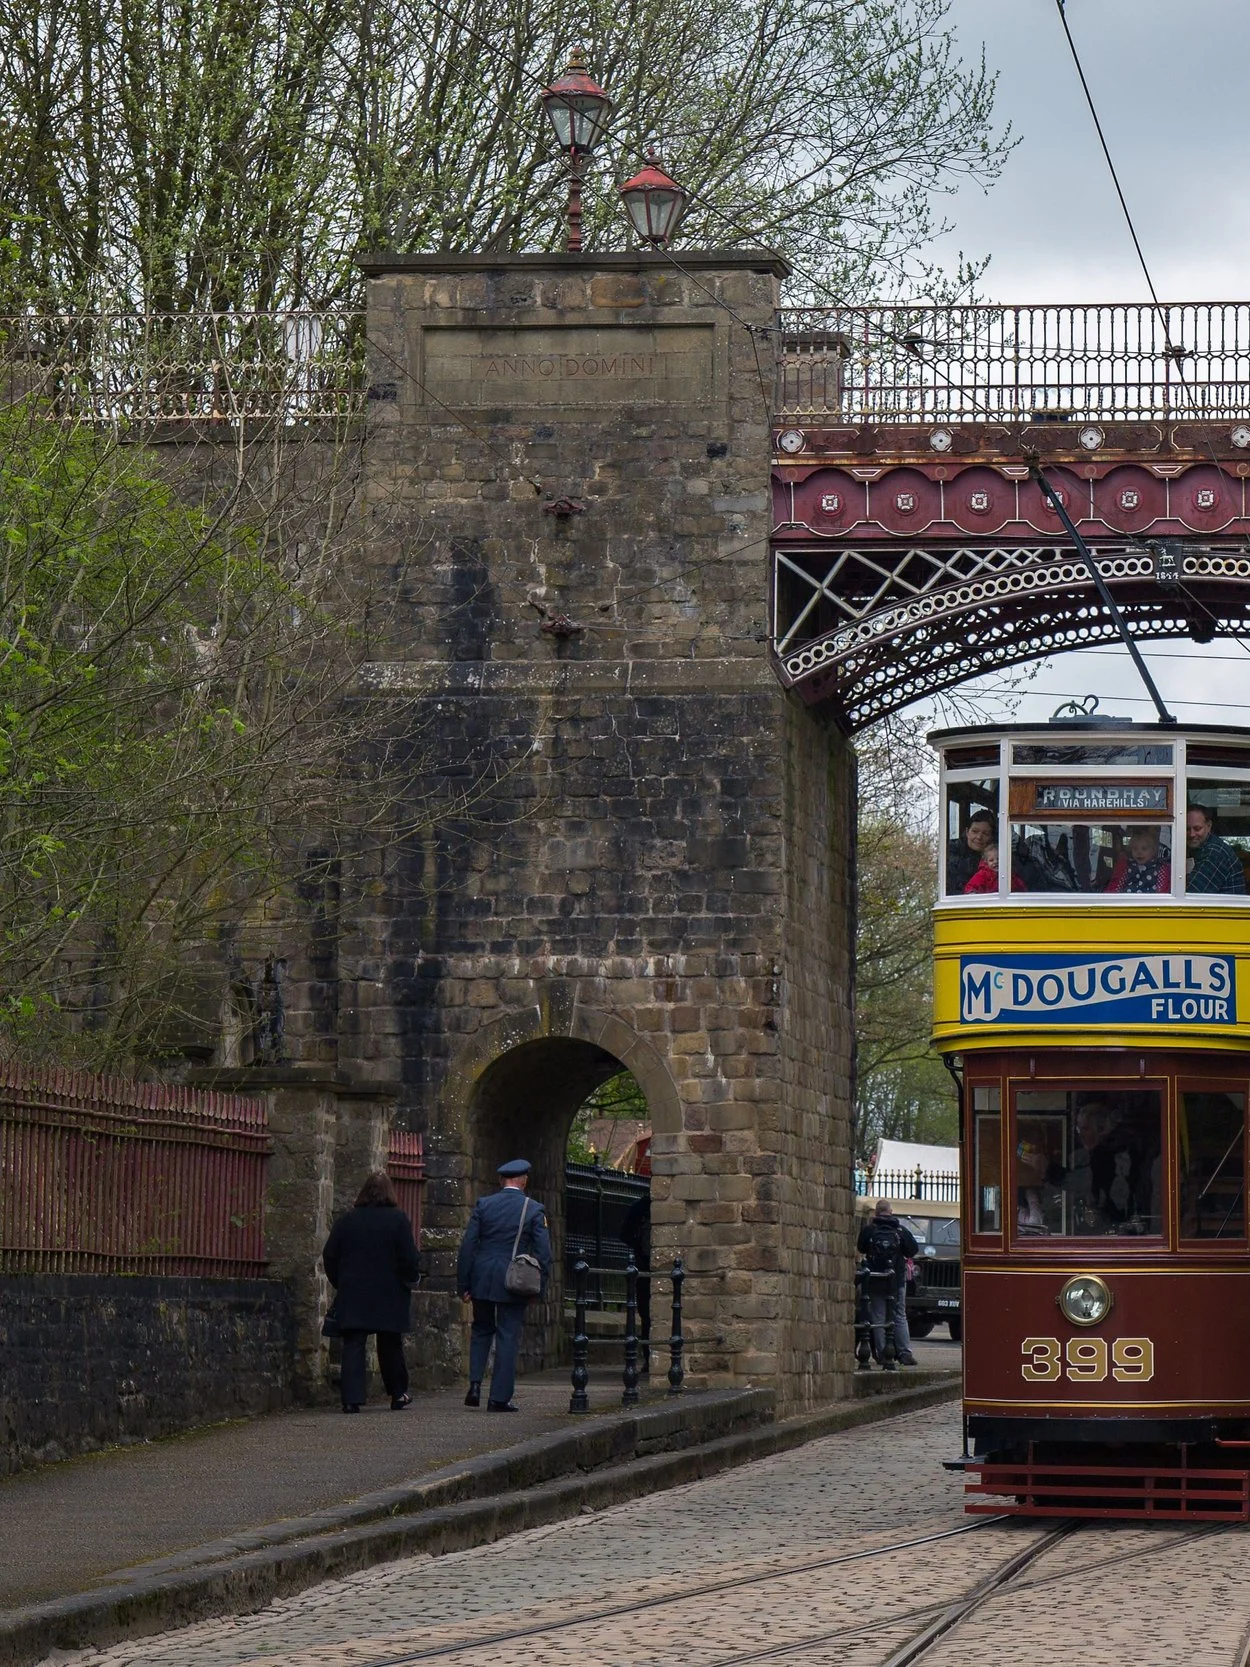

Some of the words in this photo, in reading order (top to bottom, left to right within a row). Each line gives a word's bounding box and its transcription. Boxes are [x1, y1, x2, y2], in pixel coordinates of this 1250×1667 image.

[485, 359, 555, 377] ANNO
[565, 358, 653, 376] DOMINI
[1043, 789, 1162, 805] ROUNDHAY
[1151, 998, 1228, 1020] FLOUR
[1021, 1337, 1154, 1382] 399
